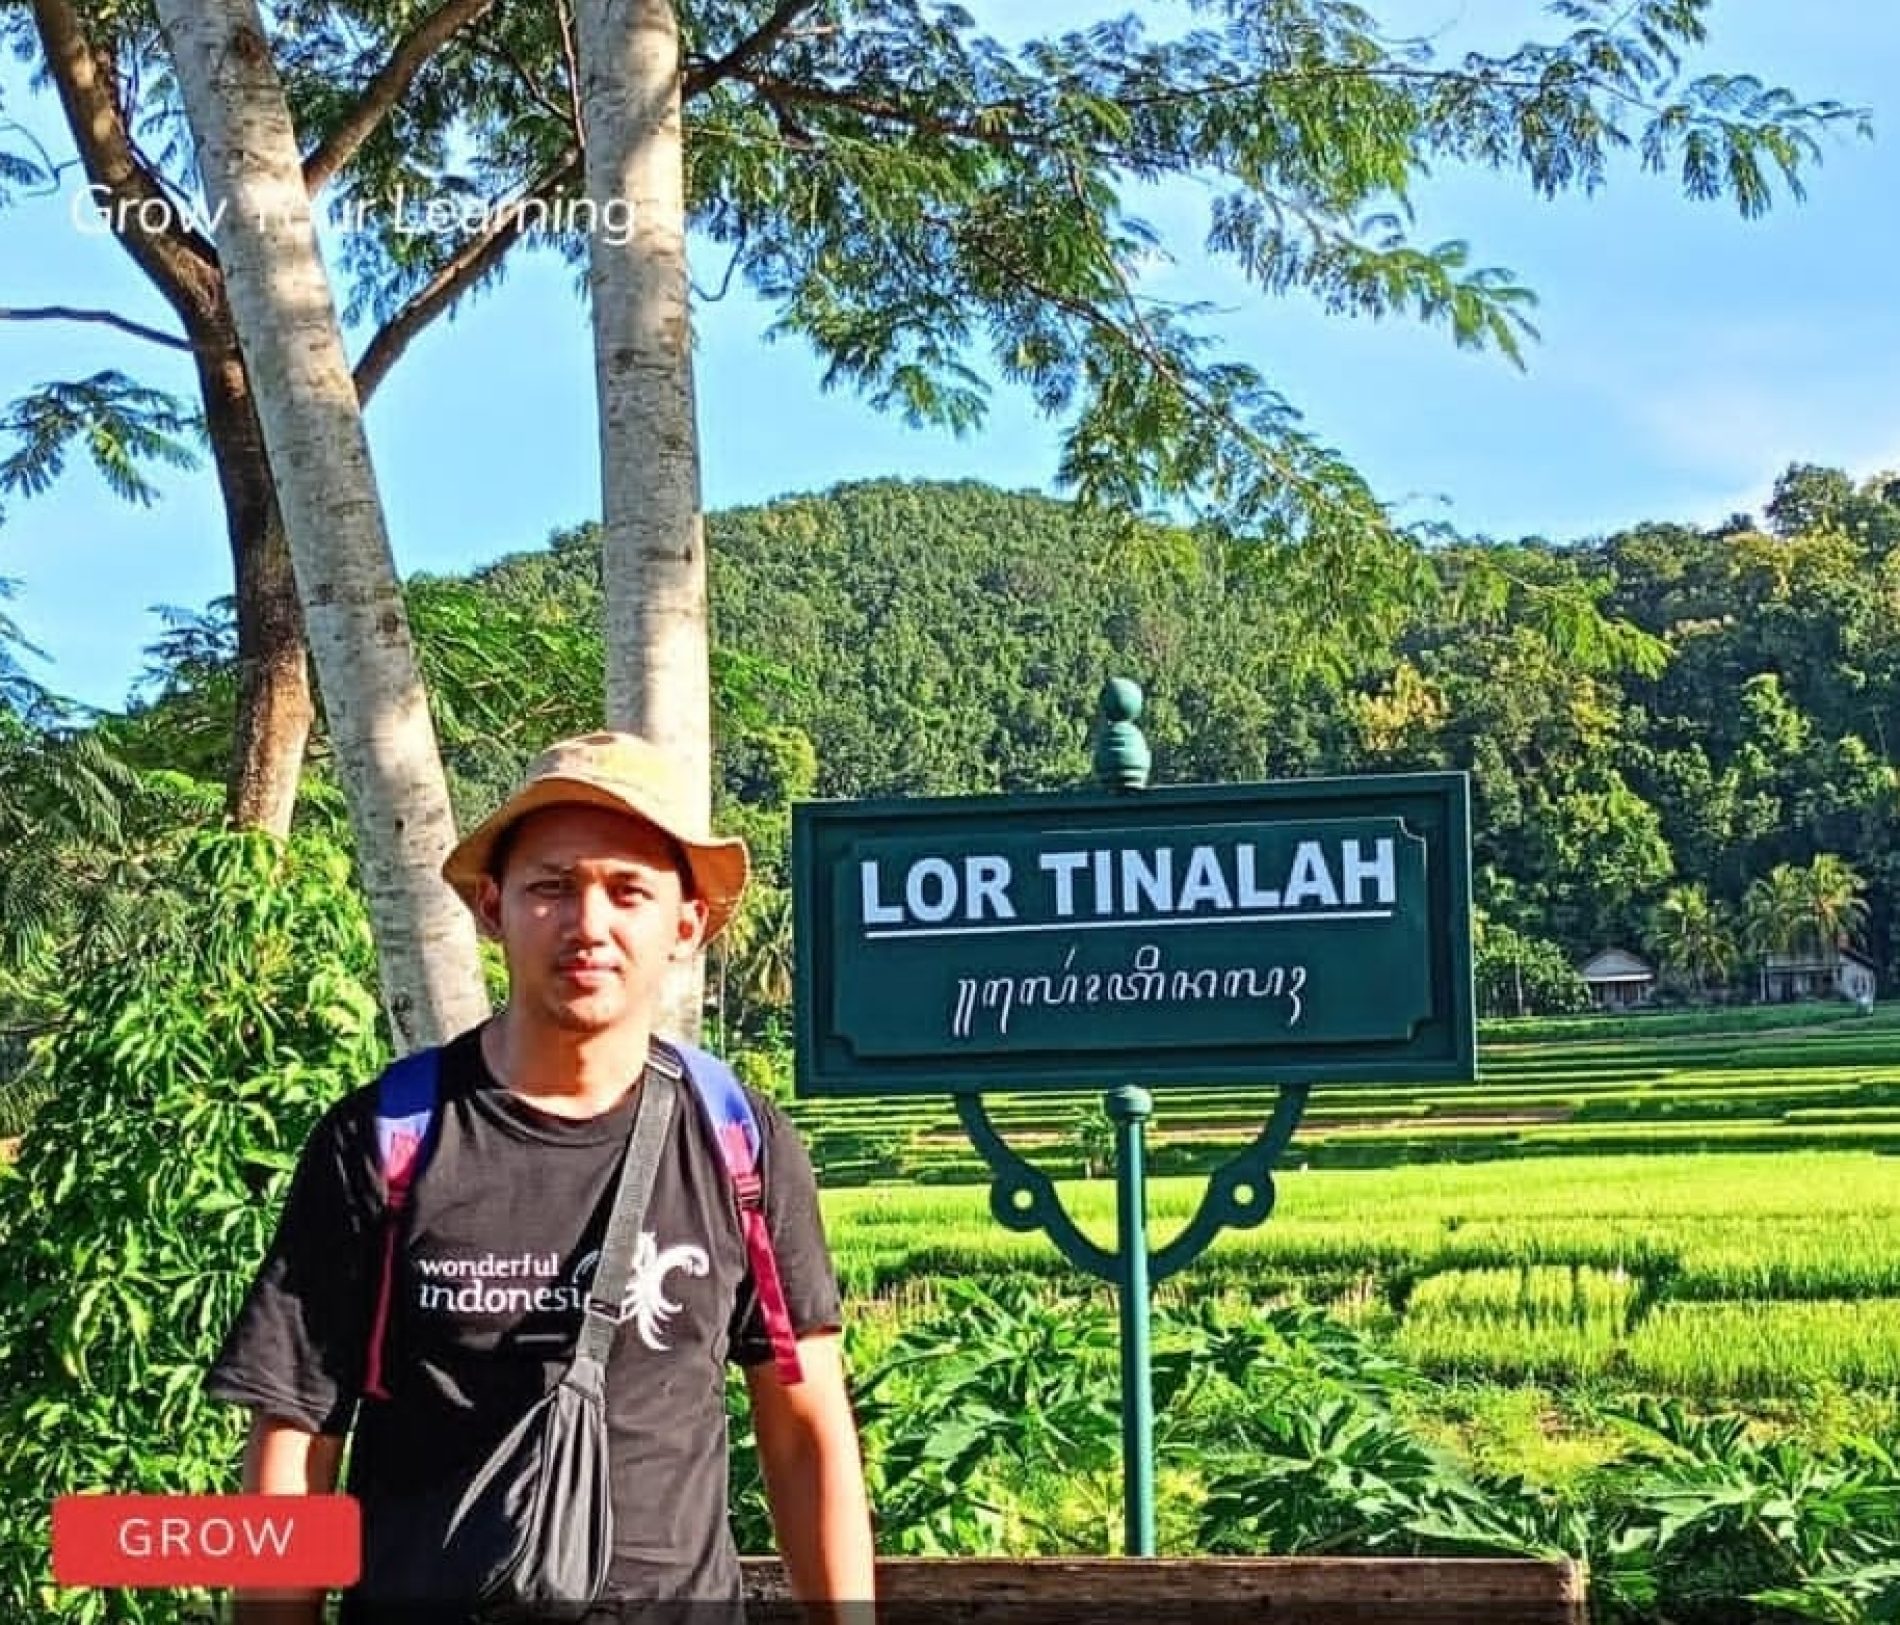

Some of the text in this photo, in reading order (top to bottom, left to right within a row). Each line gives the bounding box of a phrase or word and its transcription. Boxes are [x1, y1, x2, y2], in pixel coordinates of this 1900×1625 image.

[860, 838, 1396, 924] LOR TINALAH
[420, 1253, 560, 1277] wonderful
[419, 1280, 582, 1313] indonesi
